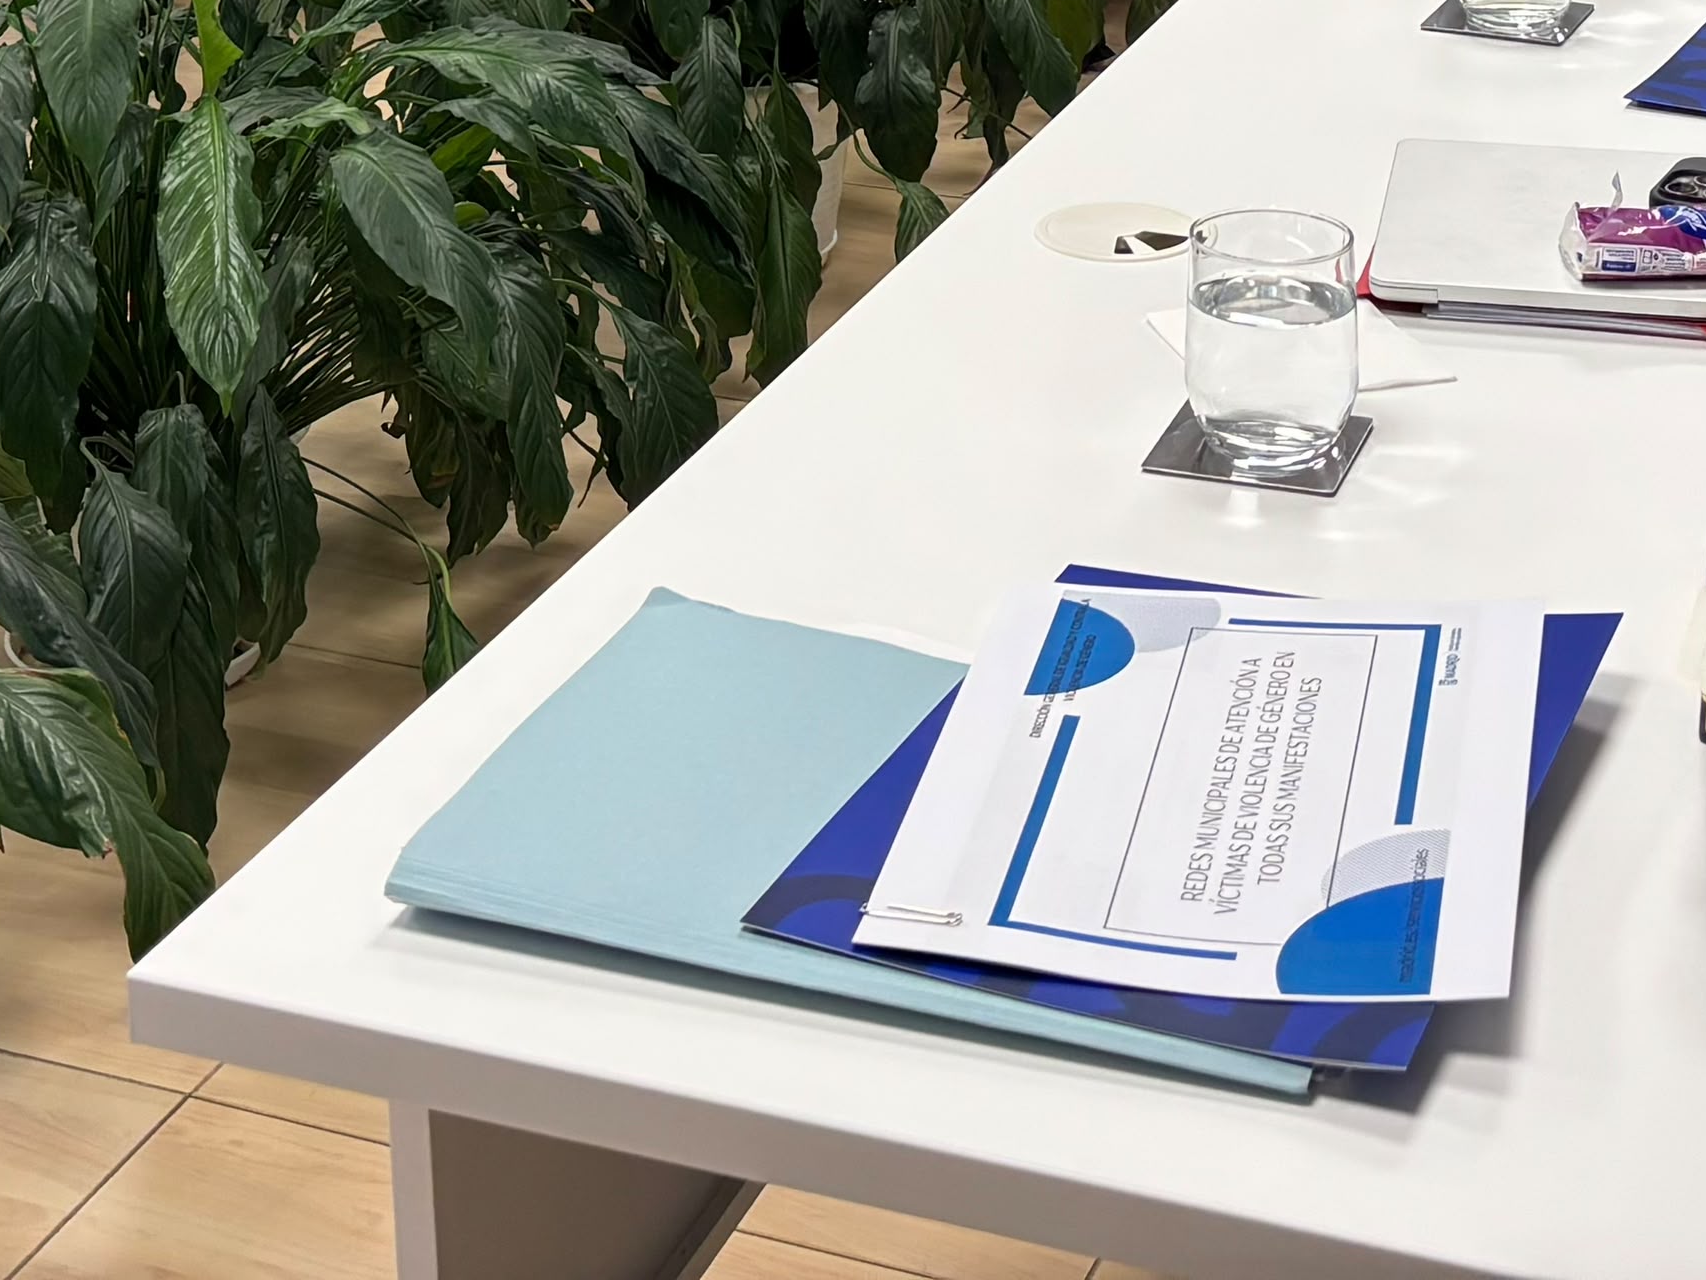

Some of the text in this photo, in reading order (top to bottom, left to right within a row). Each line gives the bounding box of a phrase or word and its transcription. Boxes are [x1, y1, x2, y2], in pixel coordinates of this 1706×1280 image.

[1181, 658, 1262, 901] REDES MUNICIPALES DE ATENCIÓN A
[1210, 651, 1295, 915] VÍCTIMAS DE VIOLENCIA DE GÉNERO EN
[1257, 677, 1322, 885] TODAS SUS MANIFESTACIONES
